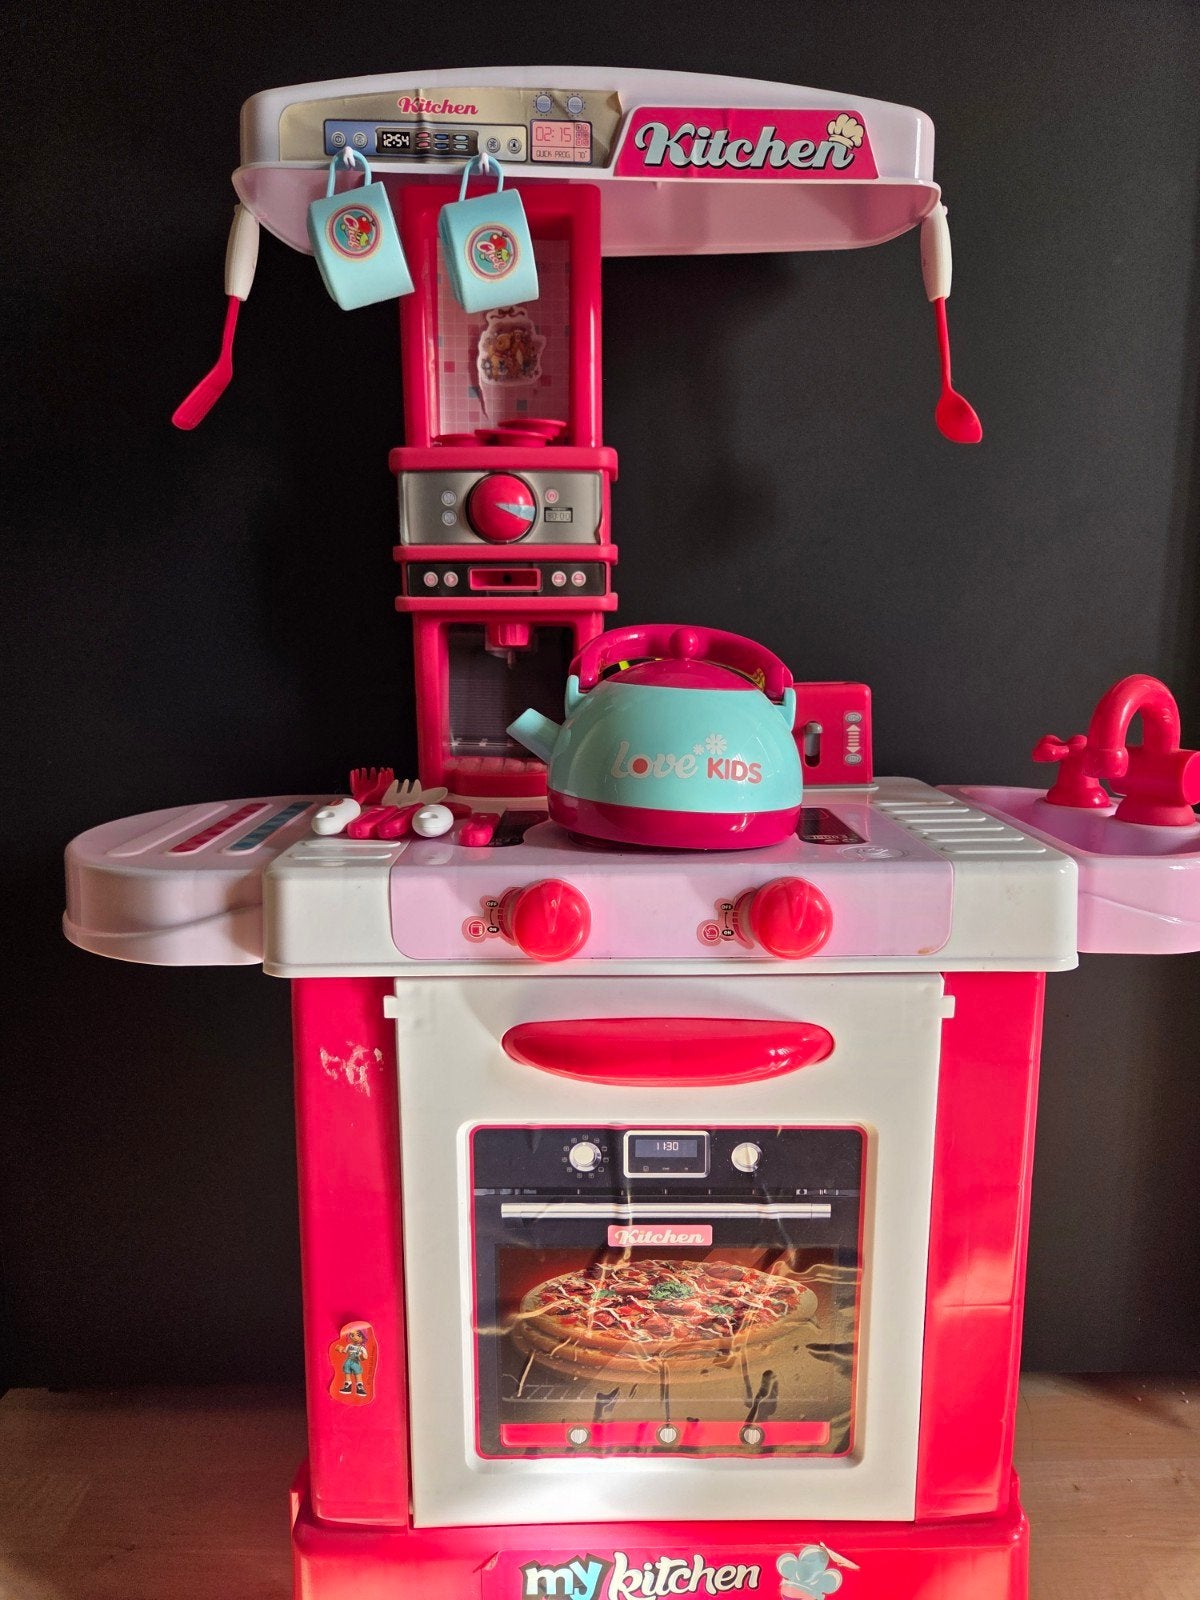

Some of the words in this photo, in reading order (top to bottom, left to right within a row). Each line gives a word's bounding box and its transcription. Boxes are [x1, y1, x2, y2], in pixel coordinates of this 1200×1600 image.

[397, 96, 479, 116] Kitchen
[633, 121, 856, 170] Kitchen
[611, 741, 698, 778] Love
[706, 757, 763, 785] KIDS
[614, 1229, 704, 1246] Kitchen
[525, 1561, 603, 1600] my
[607, 1551, 761, 1600] kitchen
